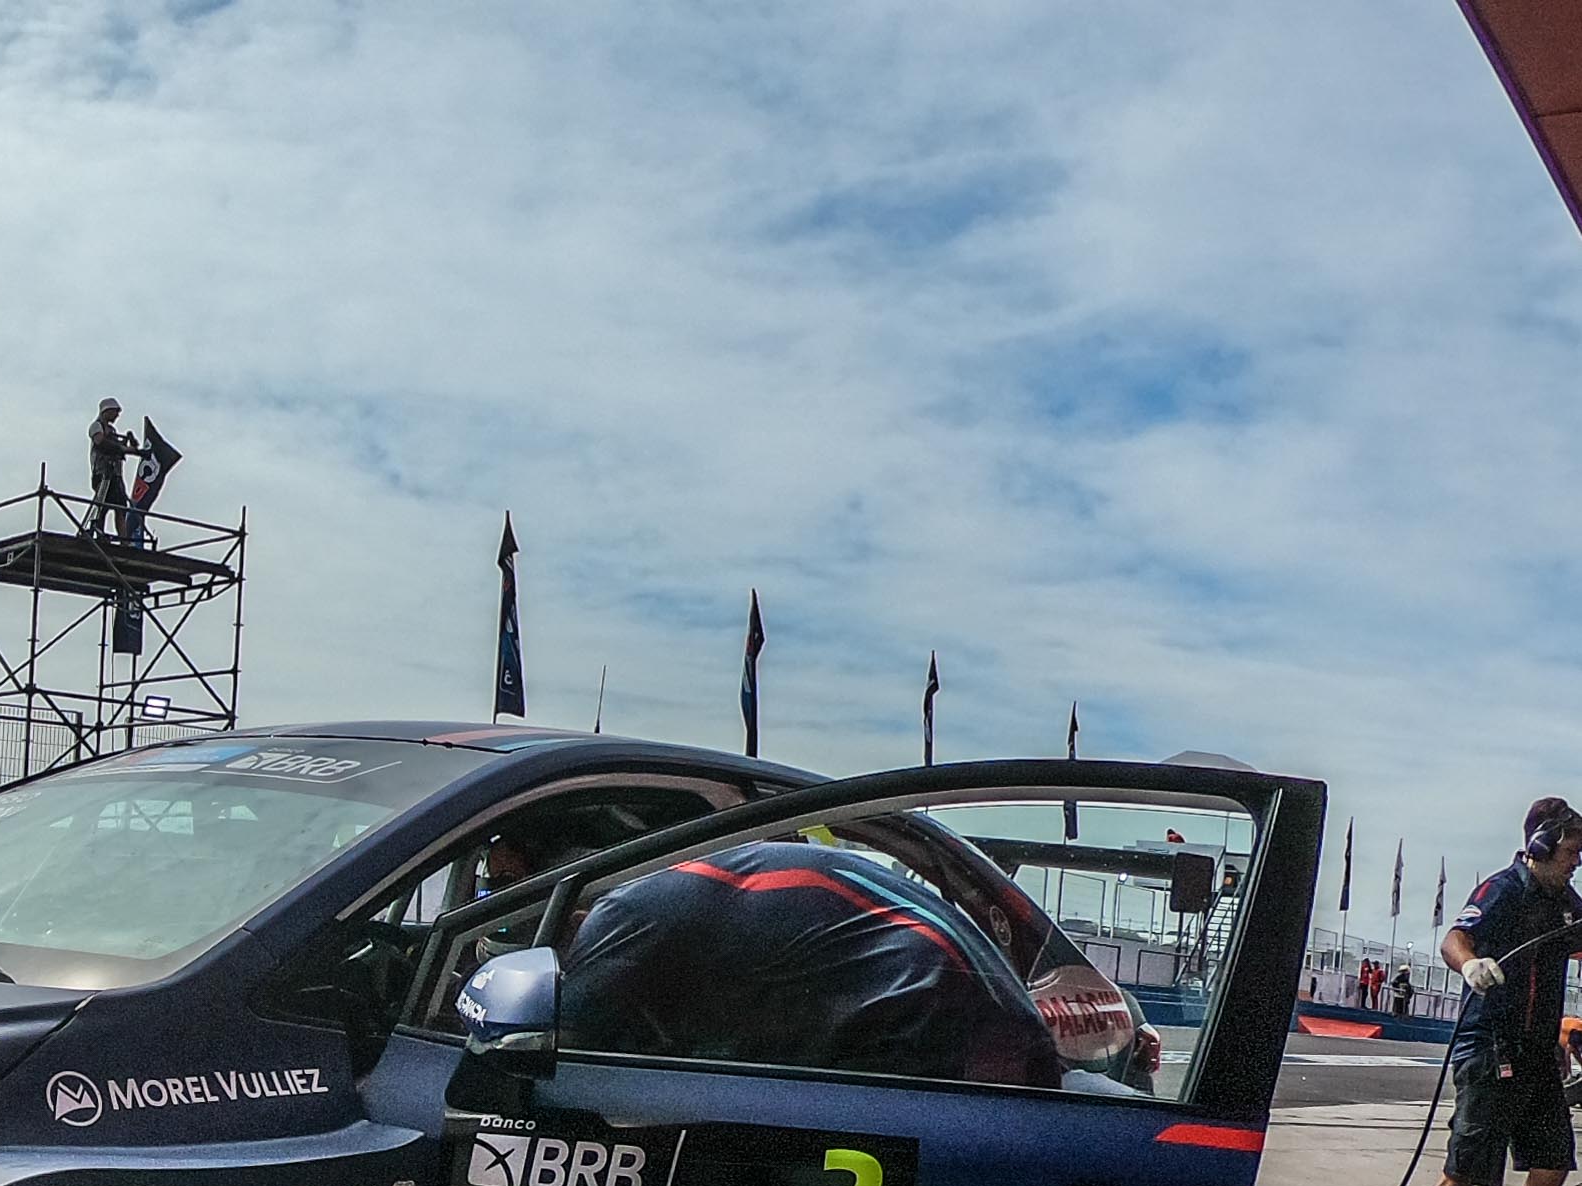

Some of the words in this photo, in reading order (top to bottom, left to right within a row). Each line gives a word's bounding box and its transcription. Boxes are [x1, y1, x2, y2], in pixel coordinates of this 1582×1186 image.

[264, 755, 361, 776] BRB
[107, 1076, 219, 1110] MOREL
[214, 1068, 329, 1100] VULLIEZ
[480, 1116, 536, 1130] banco
